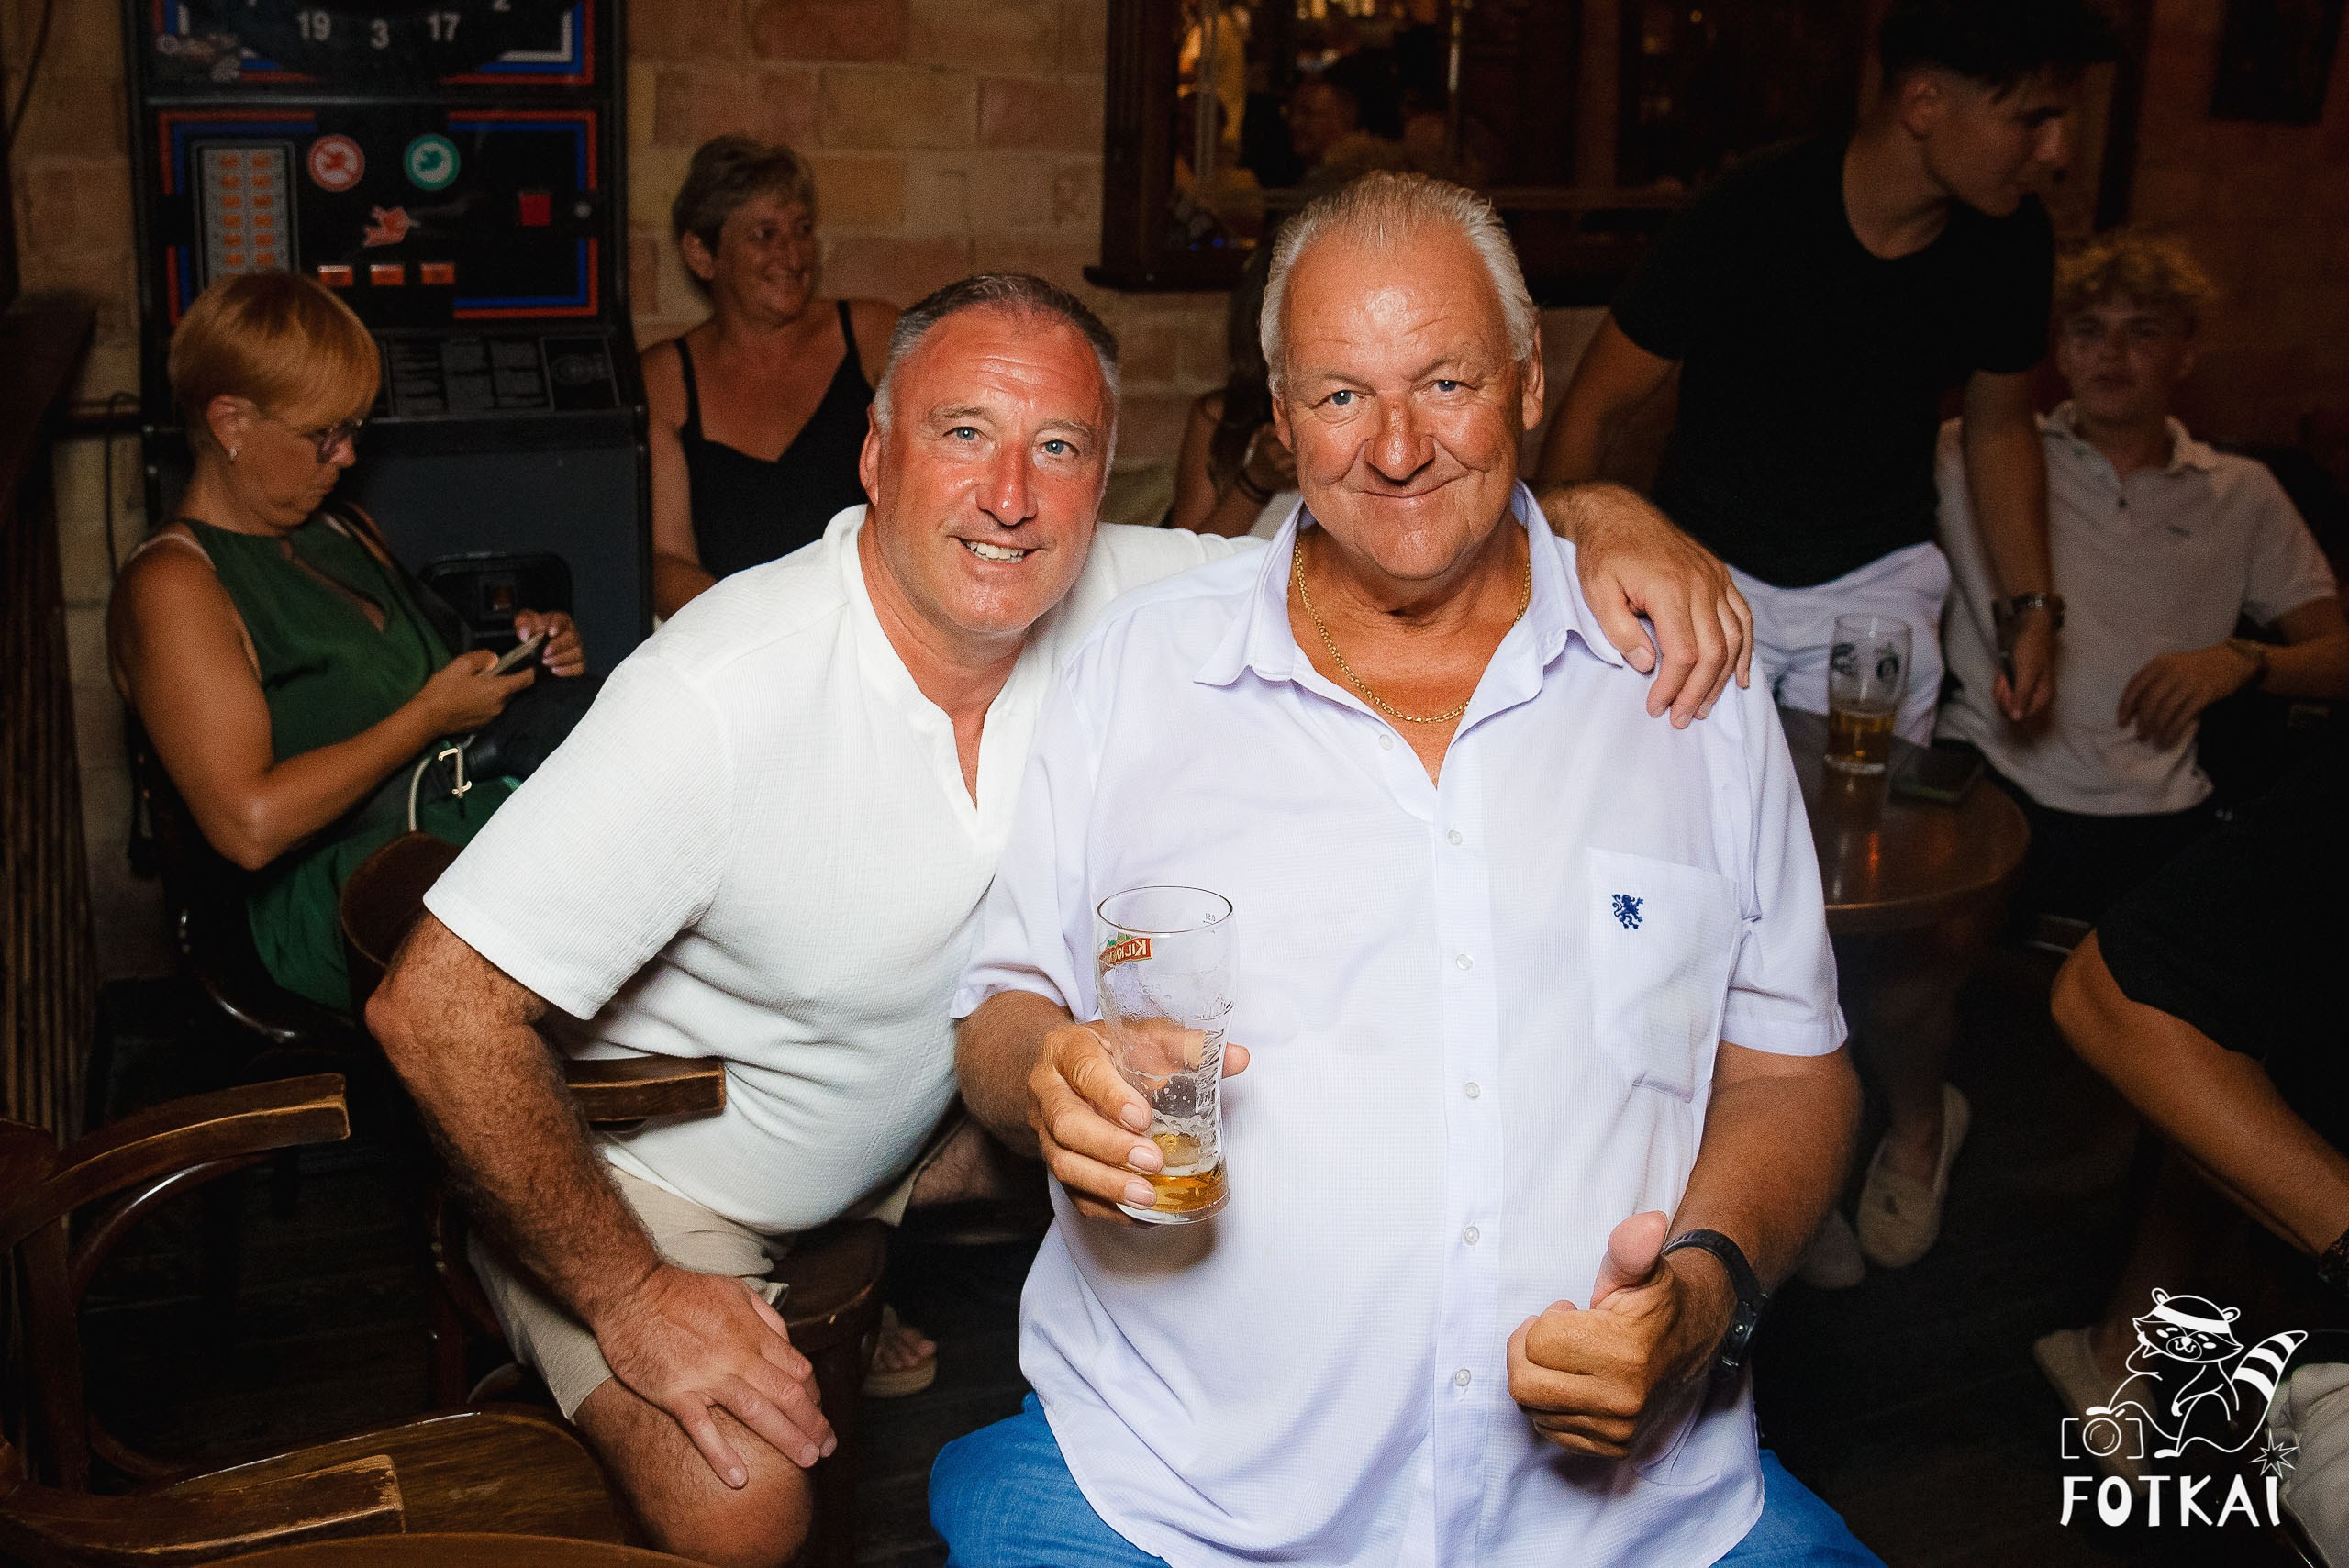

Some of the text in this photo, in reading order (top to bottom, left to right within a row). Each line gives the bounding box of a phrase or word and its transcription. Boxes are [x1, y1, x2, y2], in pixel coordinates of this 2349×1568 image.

[297, 11, 331, 40] 19
[371, 19, 390, 49] 3
[429, 13, 461, 40] 17
